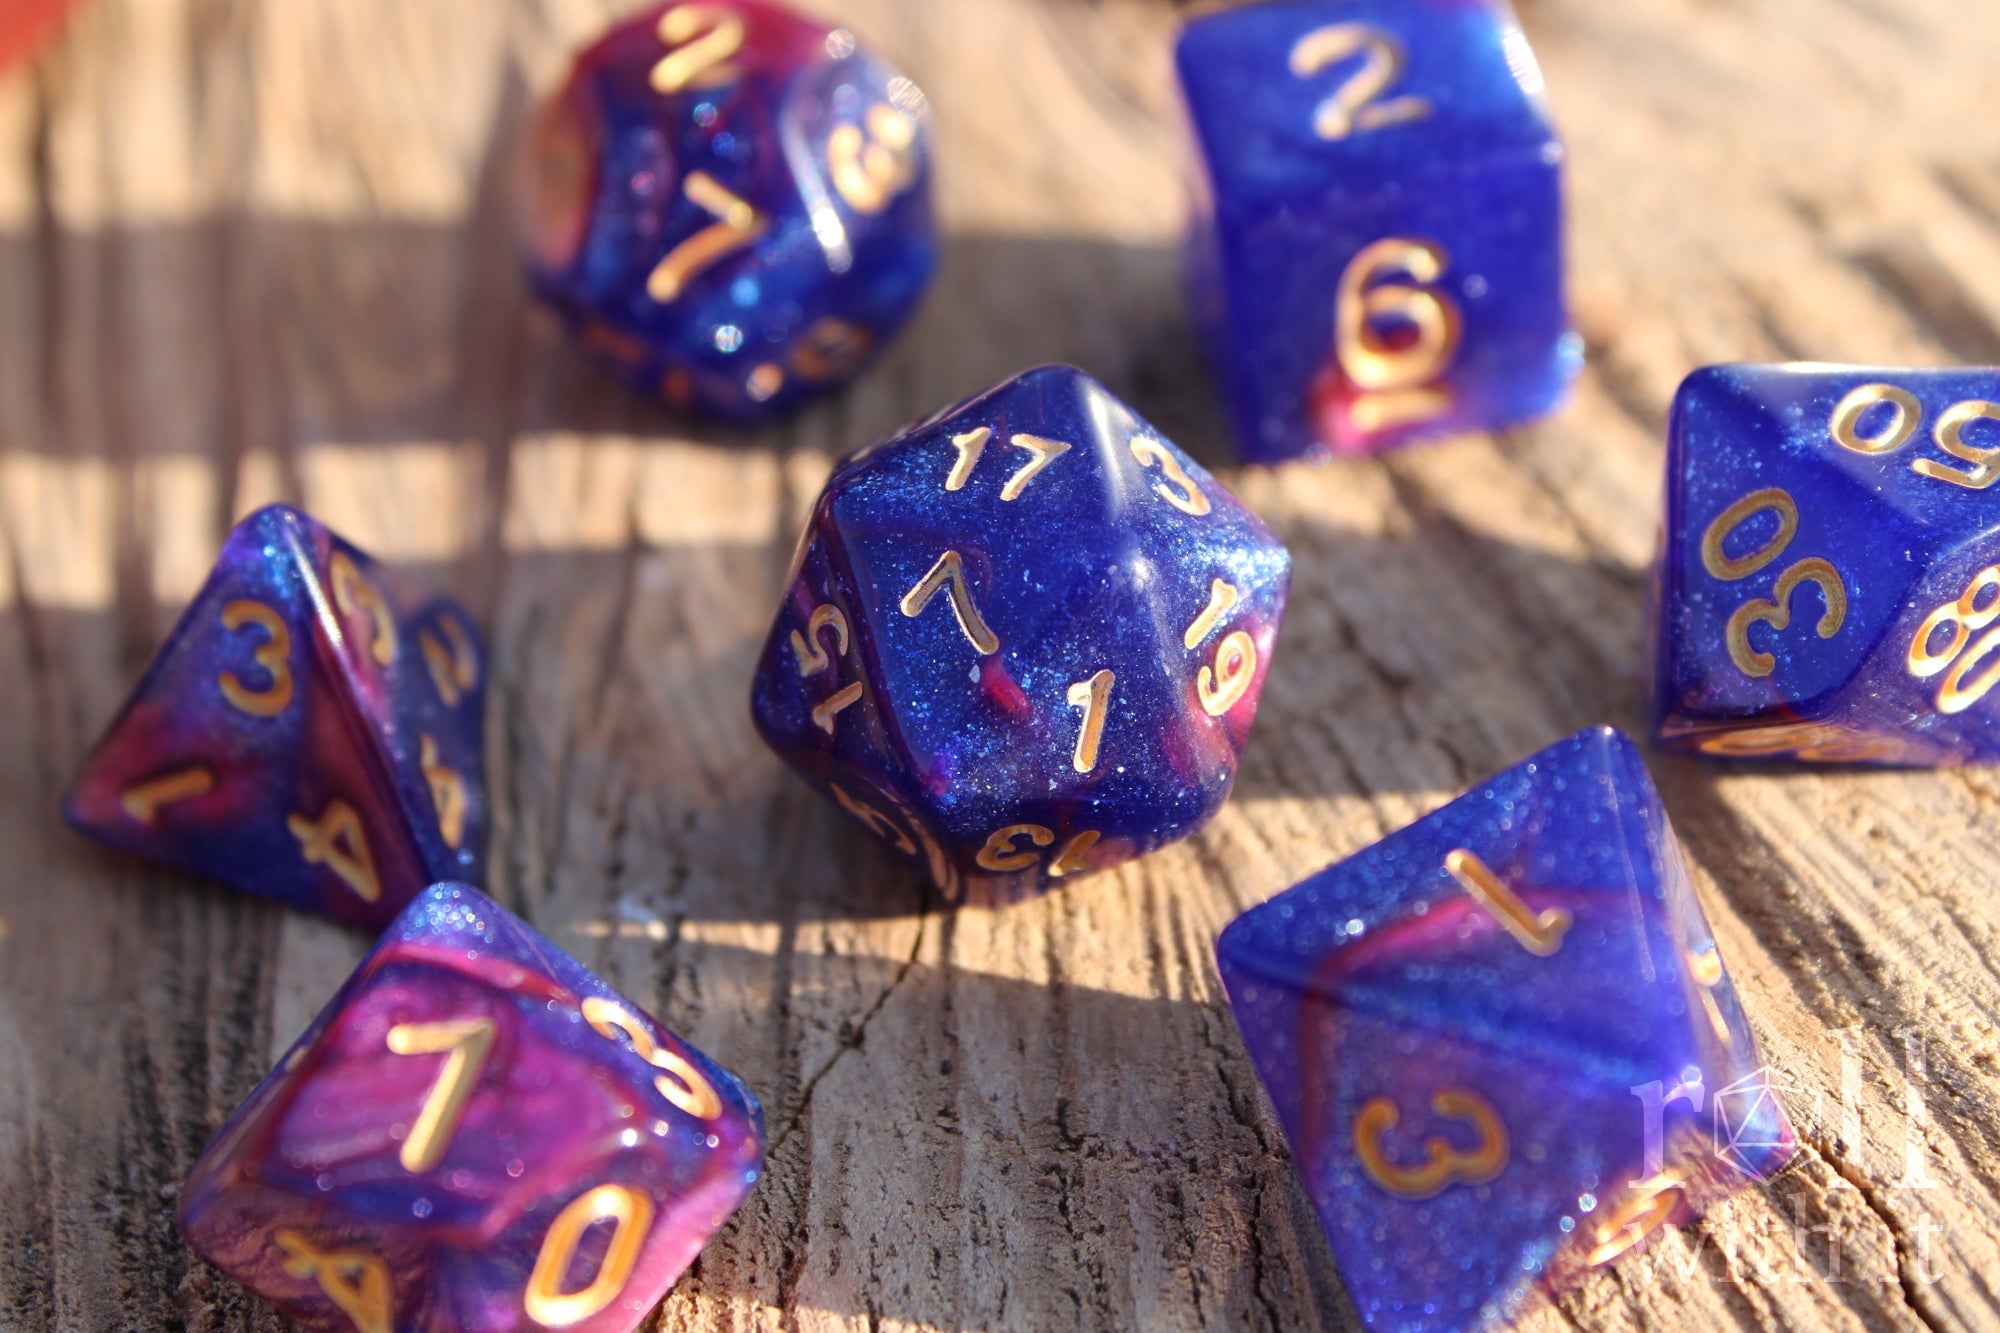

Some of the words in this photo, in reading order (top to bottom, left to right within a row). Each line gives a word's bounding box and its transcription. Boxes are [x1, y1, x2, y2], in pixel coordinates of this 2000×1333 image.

[648, 3, 746, 96] 2
[1288, 21, 1434, 141] 2
[647, 169, 769, 304] 7
[1335, 237, 1460, 395] 6
[944, 425, 1072, 503] 17
[1129, 435, 1211, 517] 3
[900, 549, 1001, 657] 7
[1701, 486, 1847, 679] 30
[218, 598, 295, 718] 3
[789, 602, 865, 736] 15
[1183, 576, 1258, 717] 19
[1066, 667, 1118, 775] 1
[120, 764, 217, 825] 1
[286, 799, 382, 903] 4
[975, 822, 1103, 878] 13
[1445, 847, 1576, 958] 1
[385, 1015, 496, 1174] 7
[580, 996, 724, 1121] 3
[1351, 1087, 1512, 1198] 3
[523, 1182, 656, 1328] 0
